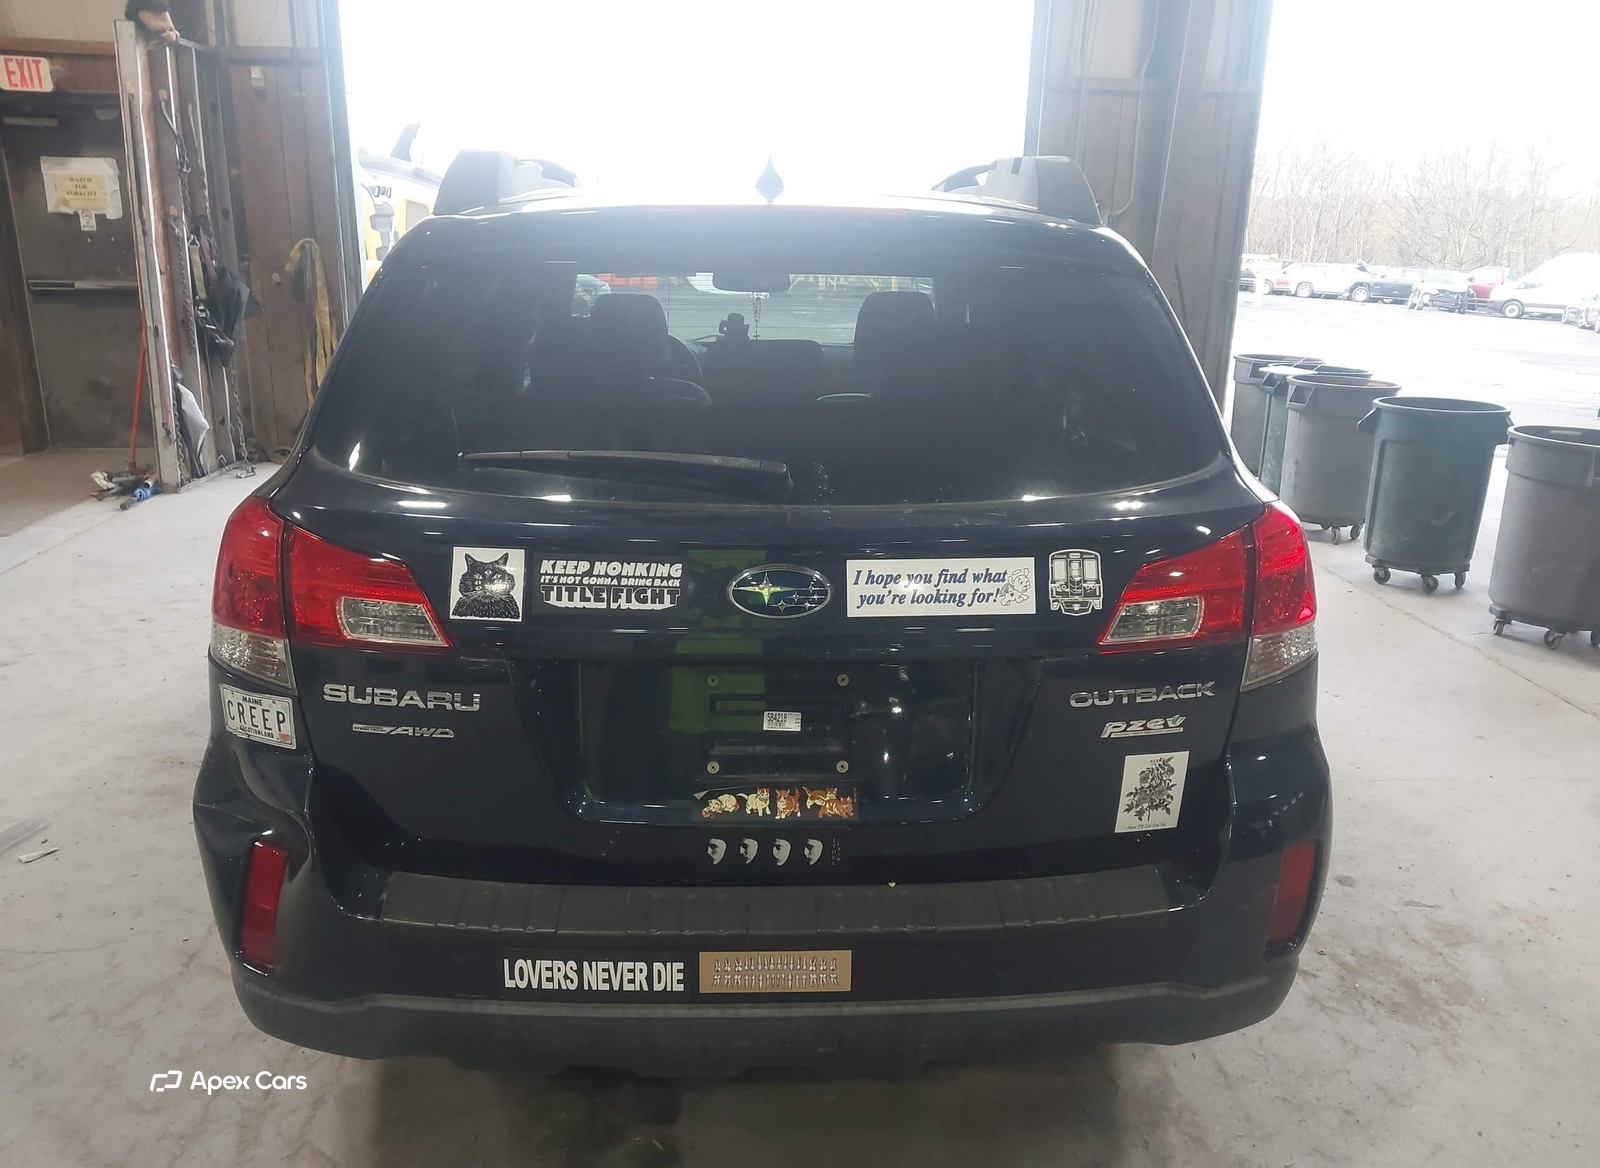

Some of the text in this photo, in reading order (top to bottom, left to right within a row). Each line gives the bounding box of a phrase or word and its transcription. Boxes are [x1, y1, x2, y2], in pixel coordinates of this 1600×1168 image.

[3, 57, 44, 89] EXIT
[540, 559, 683, 577] KEEP HONKING
[853, 568, 1008, 588] I hope you find what
[540, 575, 681, 587] IT'S NOT GONNA BRING BACK
[540, 585, 681, 610] TITLE FIGHT
[857, 588, 1000, 609] you're looking for!
[242, 695, 263, 706] MAINE
[323, 683, 481, 712] SUBARU
[1069, 681, 1216, 708] OUTBACK
[227, 699, 286, 733] CREEP
[389, 726, 455, 739] AWD
[504, 958, 685, 991] LOVERS NEVER DIE
